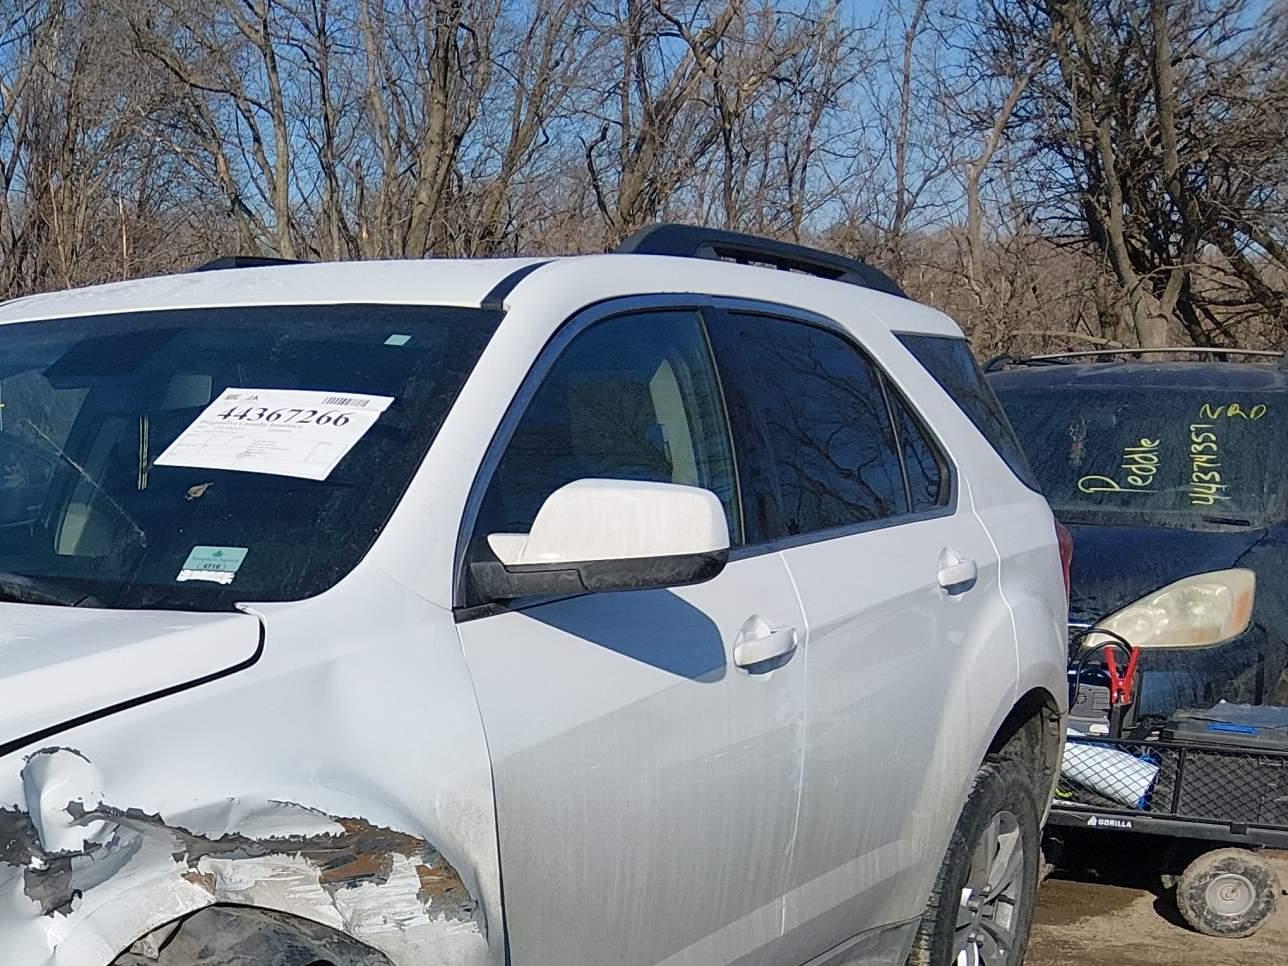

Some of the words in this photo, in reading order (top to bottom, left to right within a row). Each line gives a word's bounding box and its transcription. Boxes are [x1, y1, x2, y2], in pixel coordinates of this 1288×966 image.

[217, 405, 355, 427] 44367266
[1077, 437, 1162, 493] Peddle
[1098, 818, 1133, 829] GORILLA
